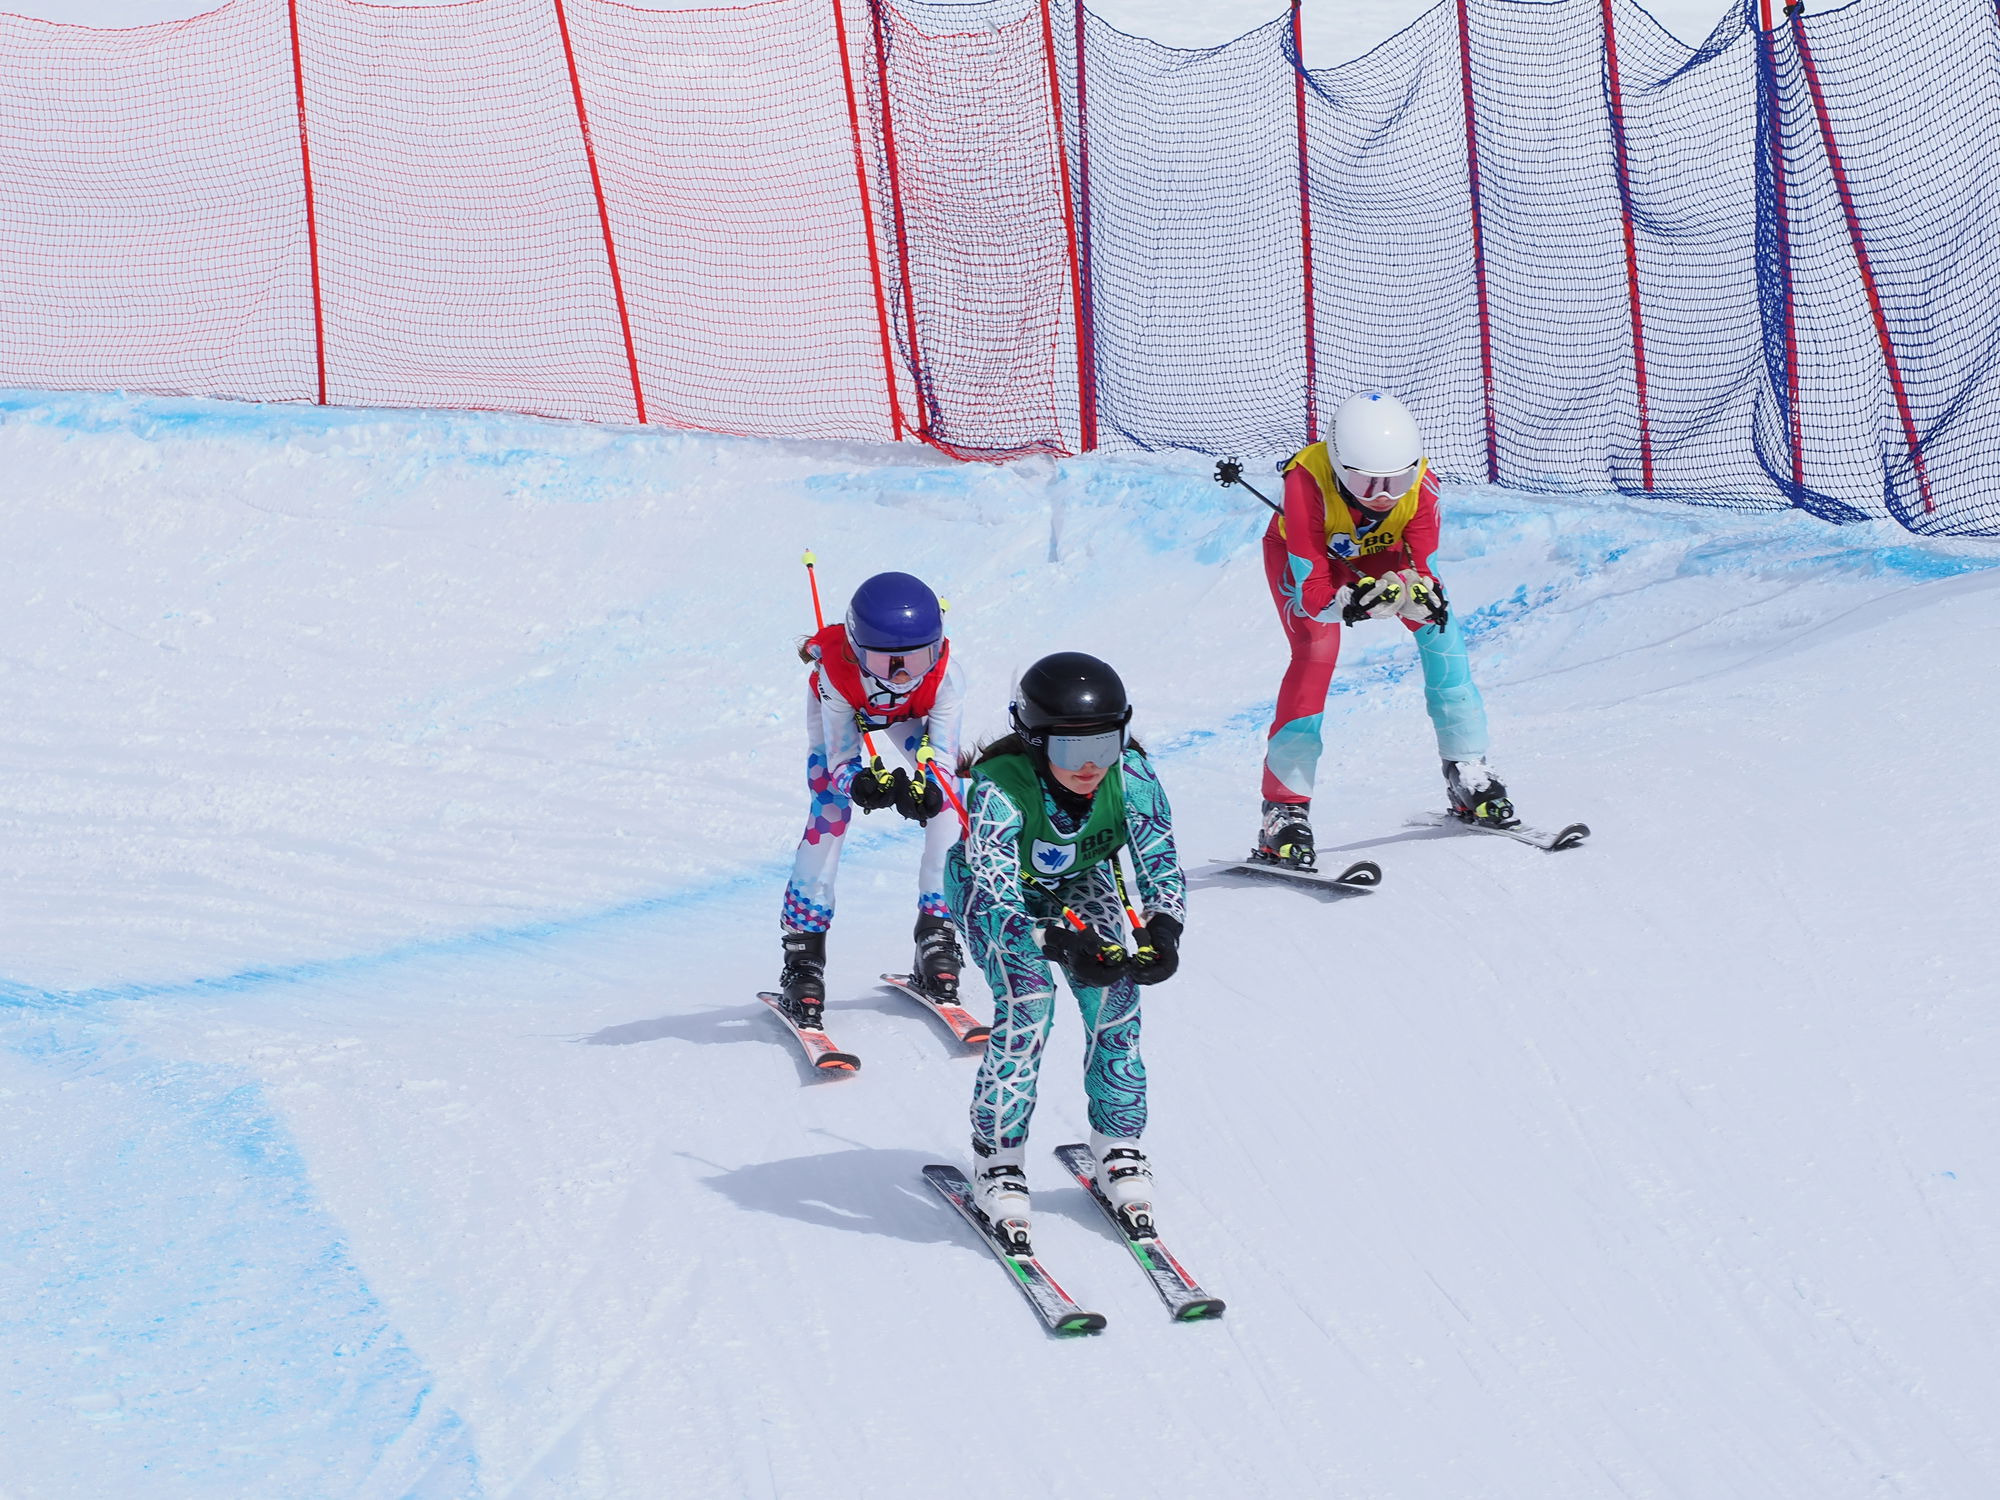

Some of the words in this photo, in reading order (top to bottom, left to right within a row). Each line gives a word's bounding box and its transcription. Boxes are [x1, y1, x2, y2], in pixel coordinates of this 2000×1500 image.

[1364, 531, 1394, 548] BC
[1081, 828, 1114, 852] BC
[1082, 842, 1110, 861] ALPINE
